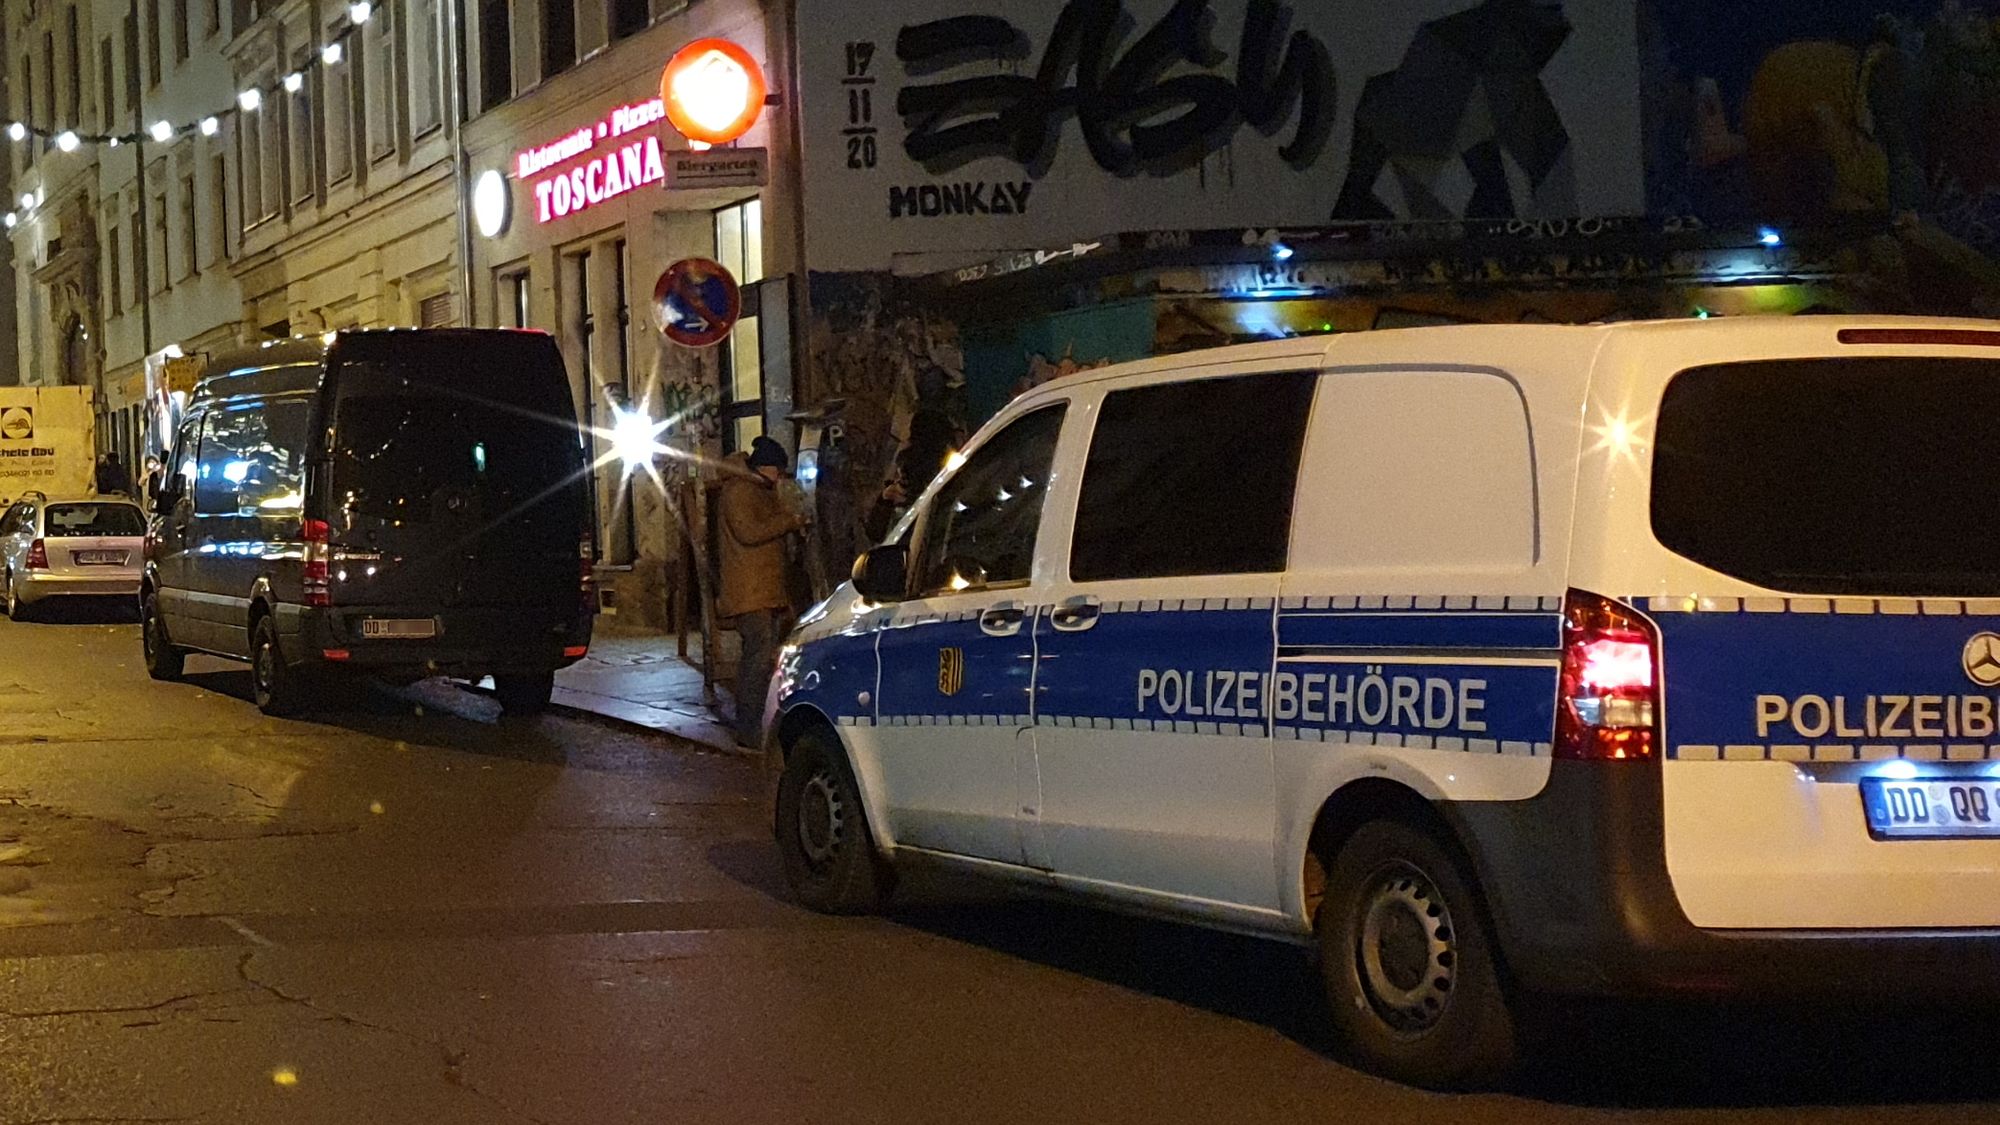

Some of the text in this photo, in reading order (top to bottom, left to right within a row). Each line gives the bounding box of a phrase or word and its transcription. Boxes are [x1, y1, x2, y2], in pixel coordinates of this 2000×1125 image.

[847, 135, 877, 169] 20
[535, 135, 666, 223] TOSCANA
[1137, 665, 1488, 732] POLIZEIBEHÖRDE
[1755, 694, 2000, 738] POLIZEIB
[1886, 787, 1930, 823] DD
[1949, 786, 1991, 822] QQ
